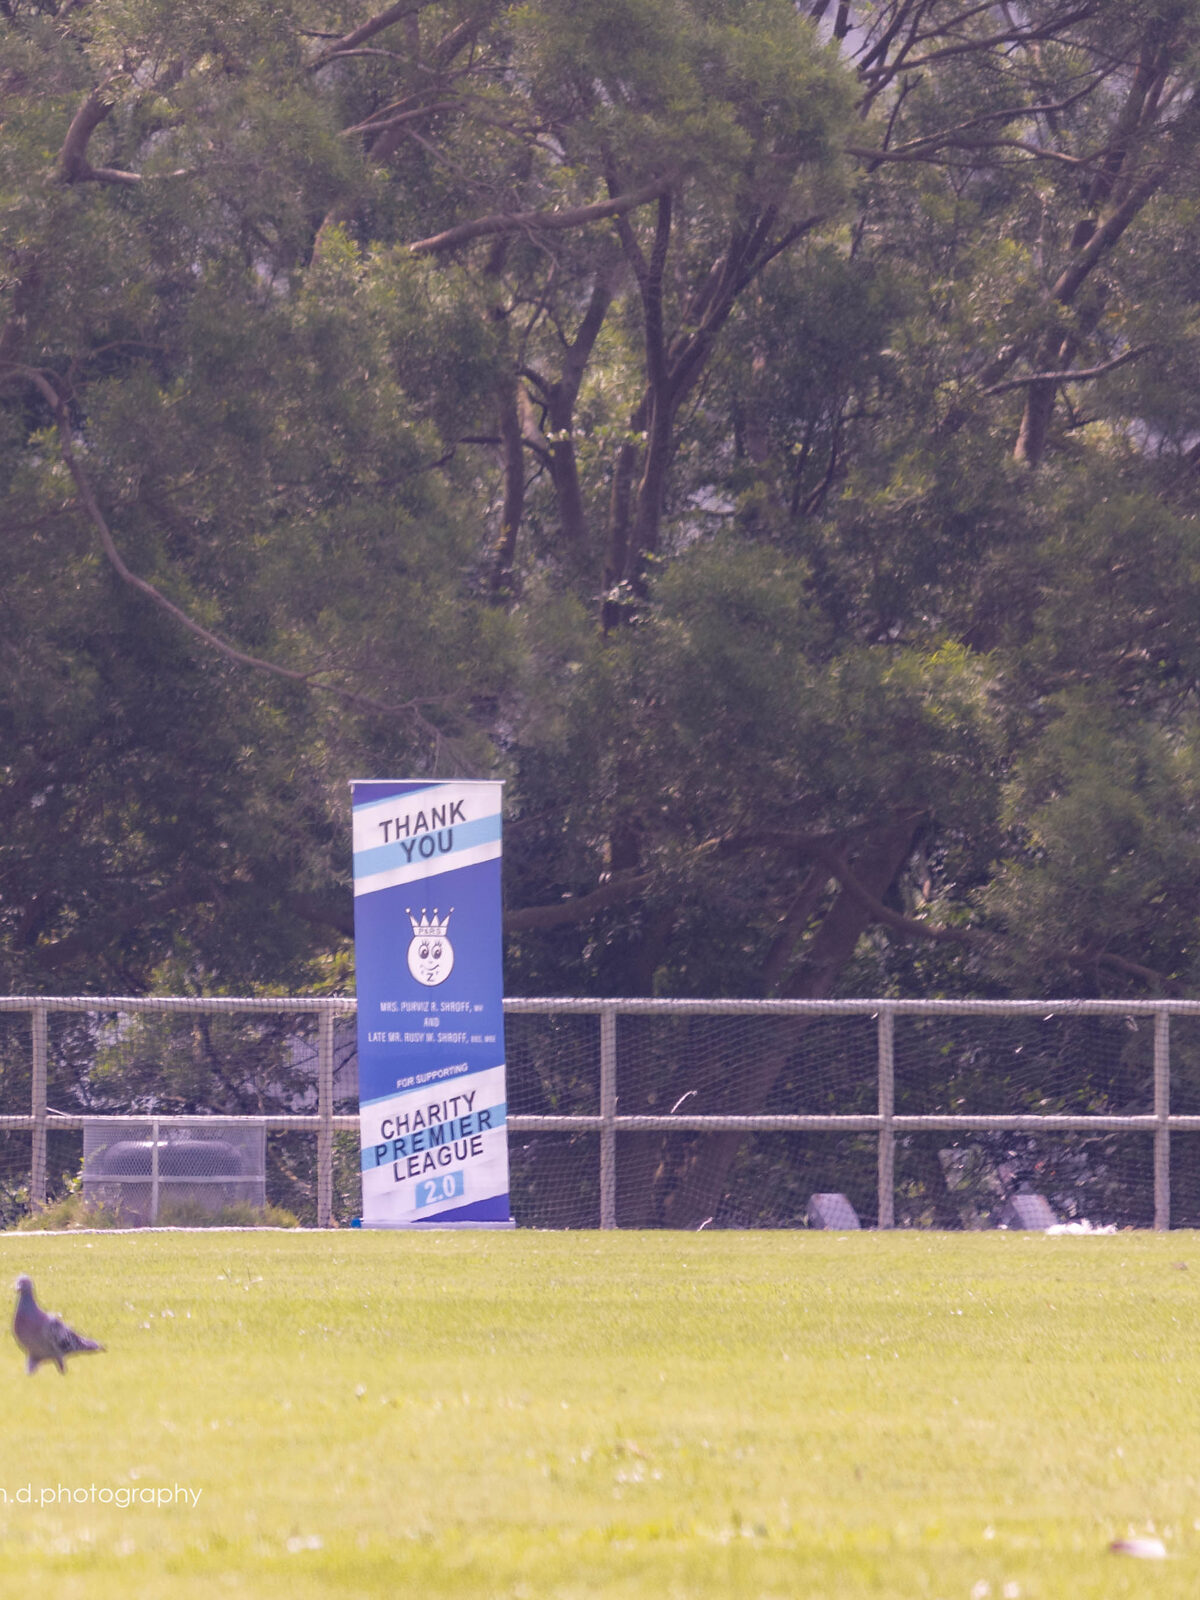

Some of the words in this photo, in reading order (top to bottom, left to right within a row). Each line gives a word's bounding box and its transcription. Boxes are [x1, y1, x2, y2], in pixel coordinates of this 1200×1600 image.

[379, 799, 467, 844] THANK
[400, 829, 454, 863] YOU
[380, 1001, 398, 1012] MRS.
[401, 1001, 429, 1012] PURVIZ
[440, 1001, 472, 1013] SHROFF,
[423, 1017, 440, 1028] AND
[368, 1032, 386, 1043] LATE
[388, 1032, 402, 1043] MR.
[404, 1032, 424, 1043] RUSY
[437, 1032, 469, 1044] SHROFF,
[396, 1076, 415, 1089] FOR
[415, 1062, 469, 1084] SUPPORTING
[380, 1090, 477, 1140] CHARITY
[374, 1109, 492, 1167] PREMIER
[392, 1135, 484, 1183] LEAGUE
[424, 1176, 457, 1204] 2.0
